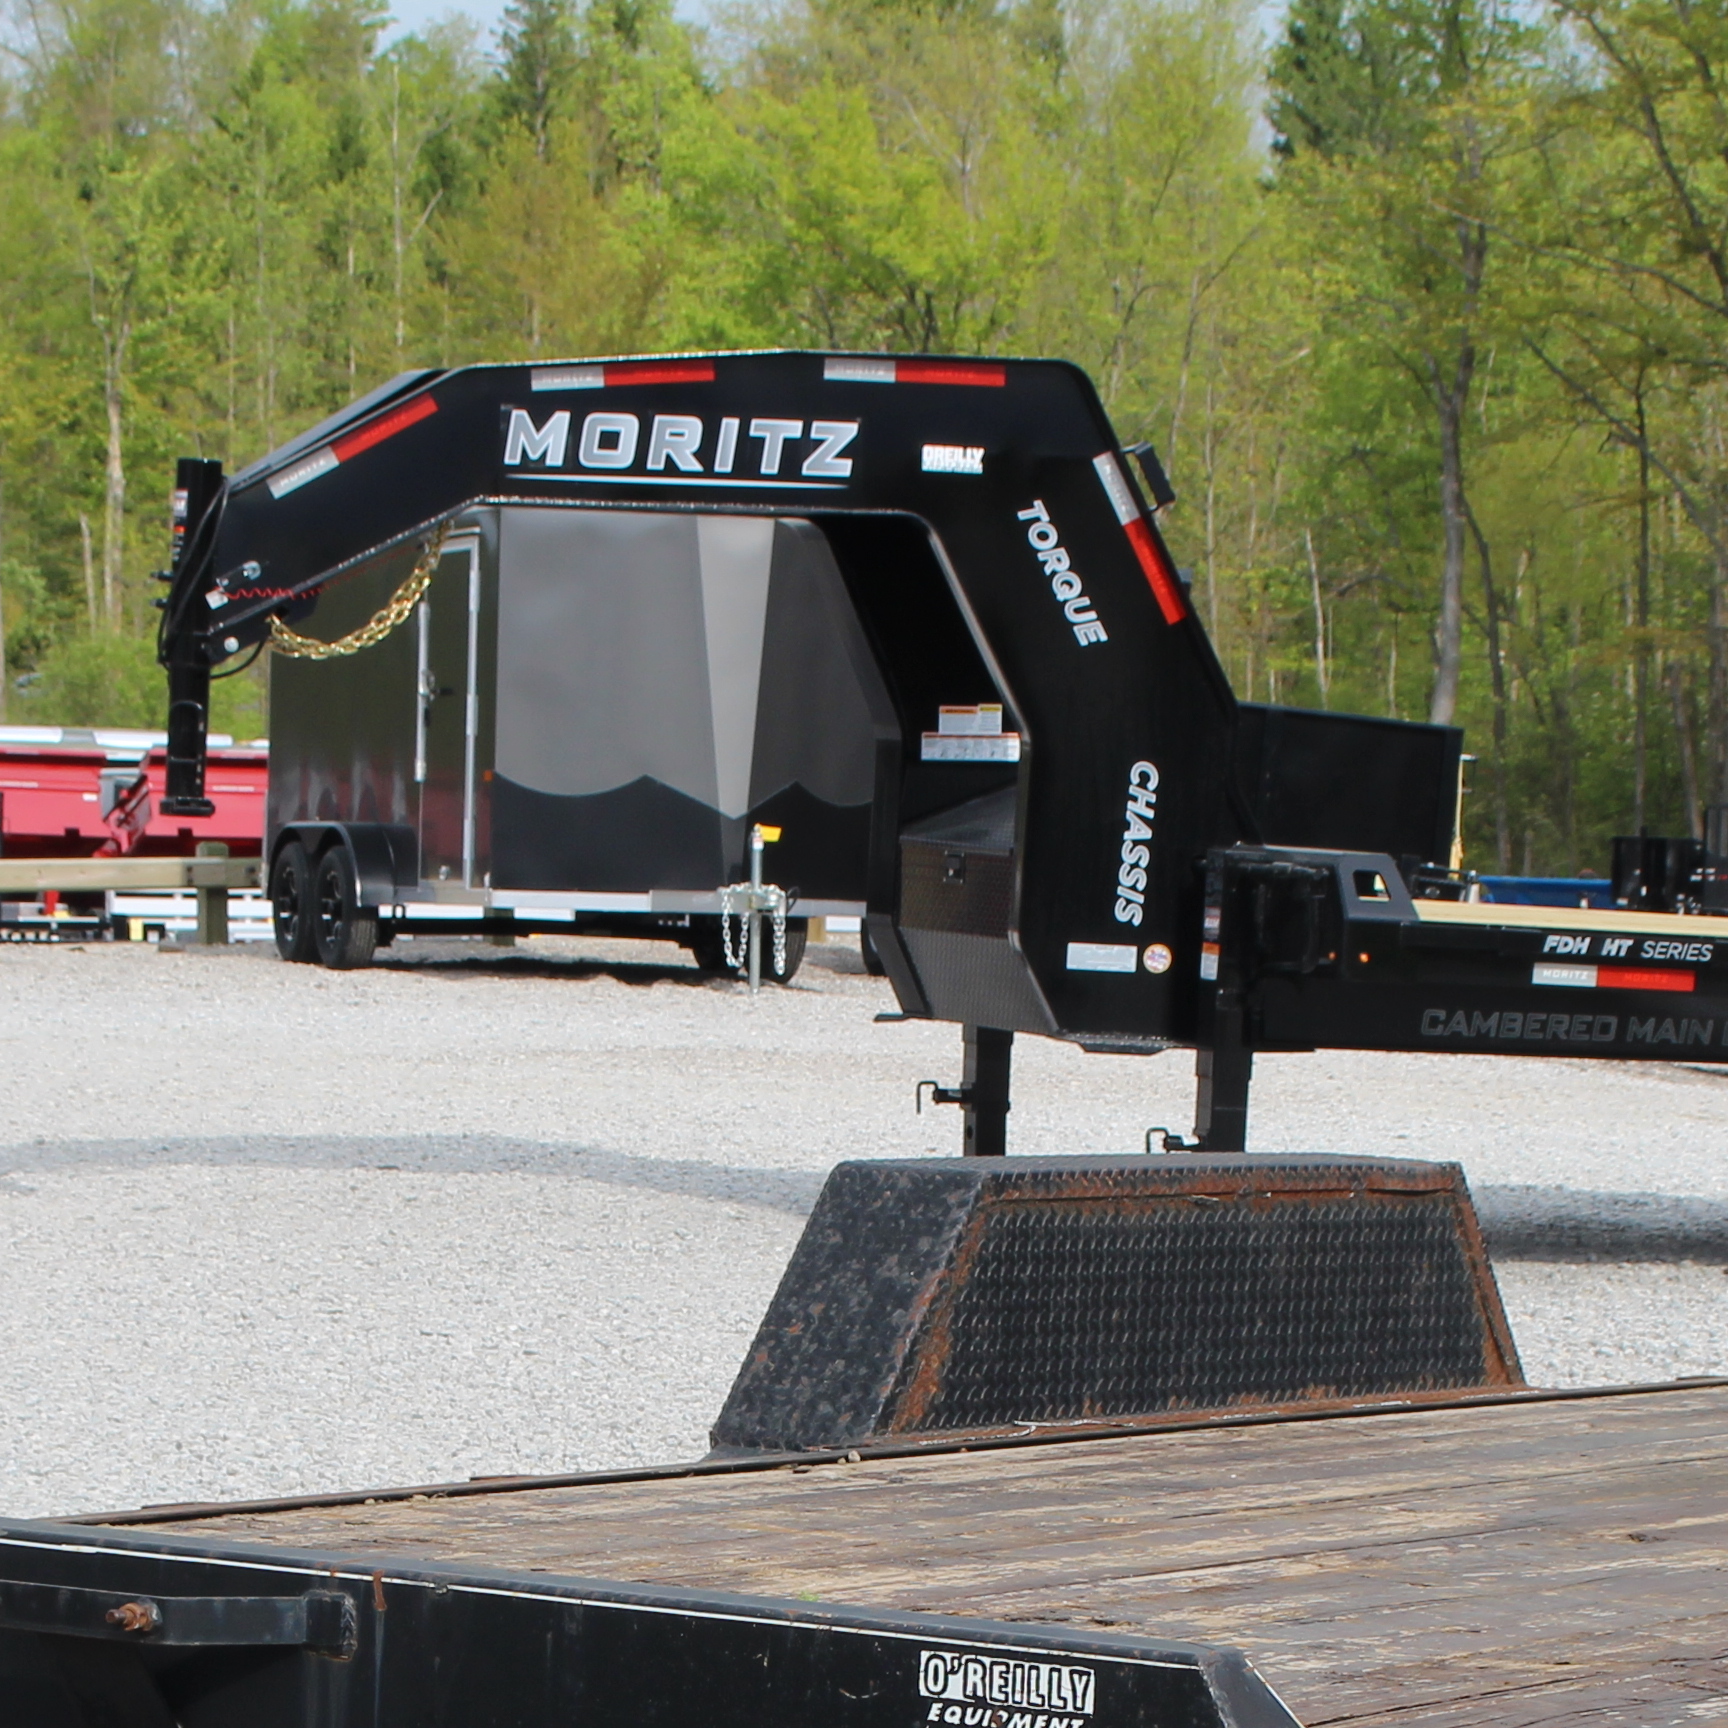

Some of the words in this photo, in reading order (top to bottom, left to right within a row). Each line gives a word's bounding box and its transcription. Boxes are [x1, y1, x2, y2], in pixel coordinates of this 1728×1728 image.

[503, 408, 860, 477] MORITZ
[1016, 499, 1109, 648] TORQUE
[1113, 760, 1160, 927] CHASSIS
[1541, 968, 1590, 981] MORITZ
[1542, 935, 1591, 956] FDH
[1600, 938, 1634, 957] HT
[1640, 940, 1714, 962] SERIES
[1420, 1007, 1618, 1043] CAMBERED
[1626, 1016, 1711, 1047] MAIN
[922, 1652, 1093, 1713] O'REILLY
